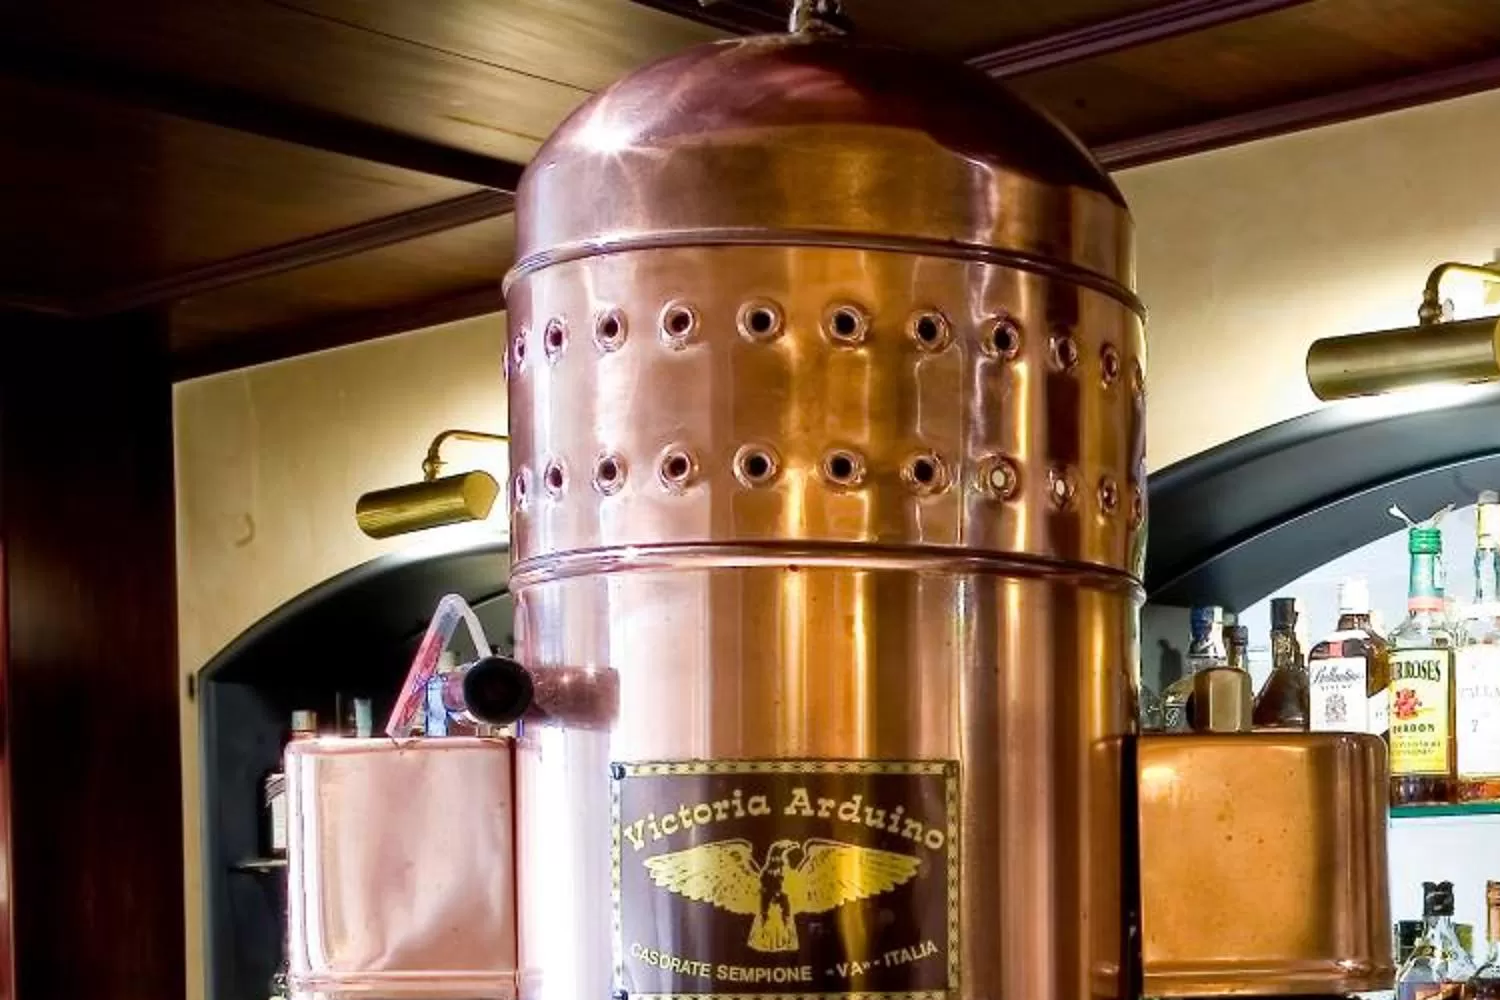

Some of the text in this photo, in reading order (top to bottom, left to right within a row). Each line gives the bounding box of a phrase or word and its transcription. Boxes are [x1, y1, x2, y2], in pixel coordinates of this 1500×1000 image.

[622, 787, 946, 852] Victoria Arduino
[629, 942, 711, 978] CASORATE
[716, 965, 813, 984] SEMPIONE
[884, 939, 939, 968] ITALIA
